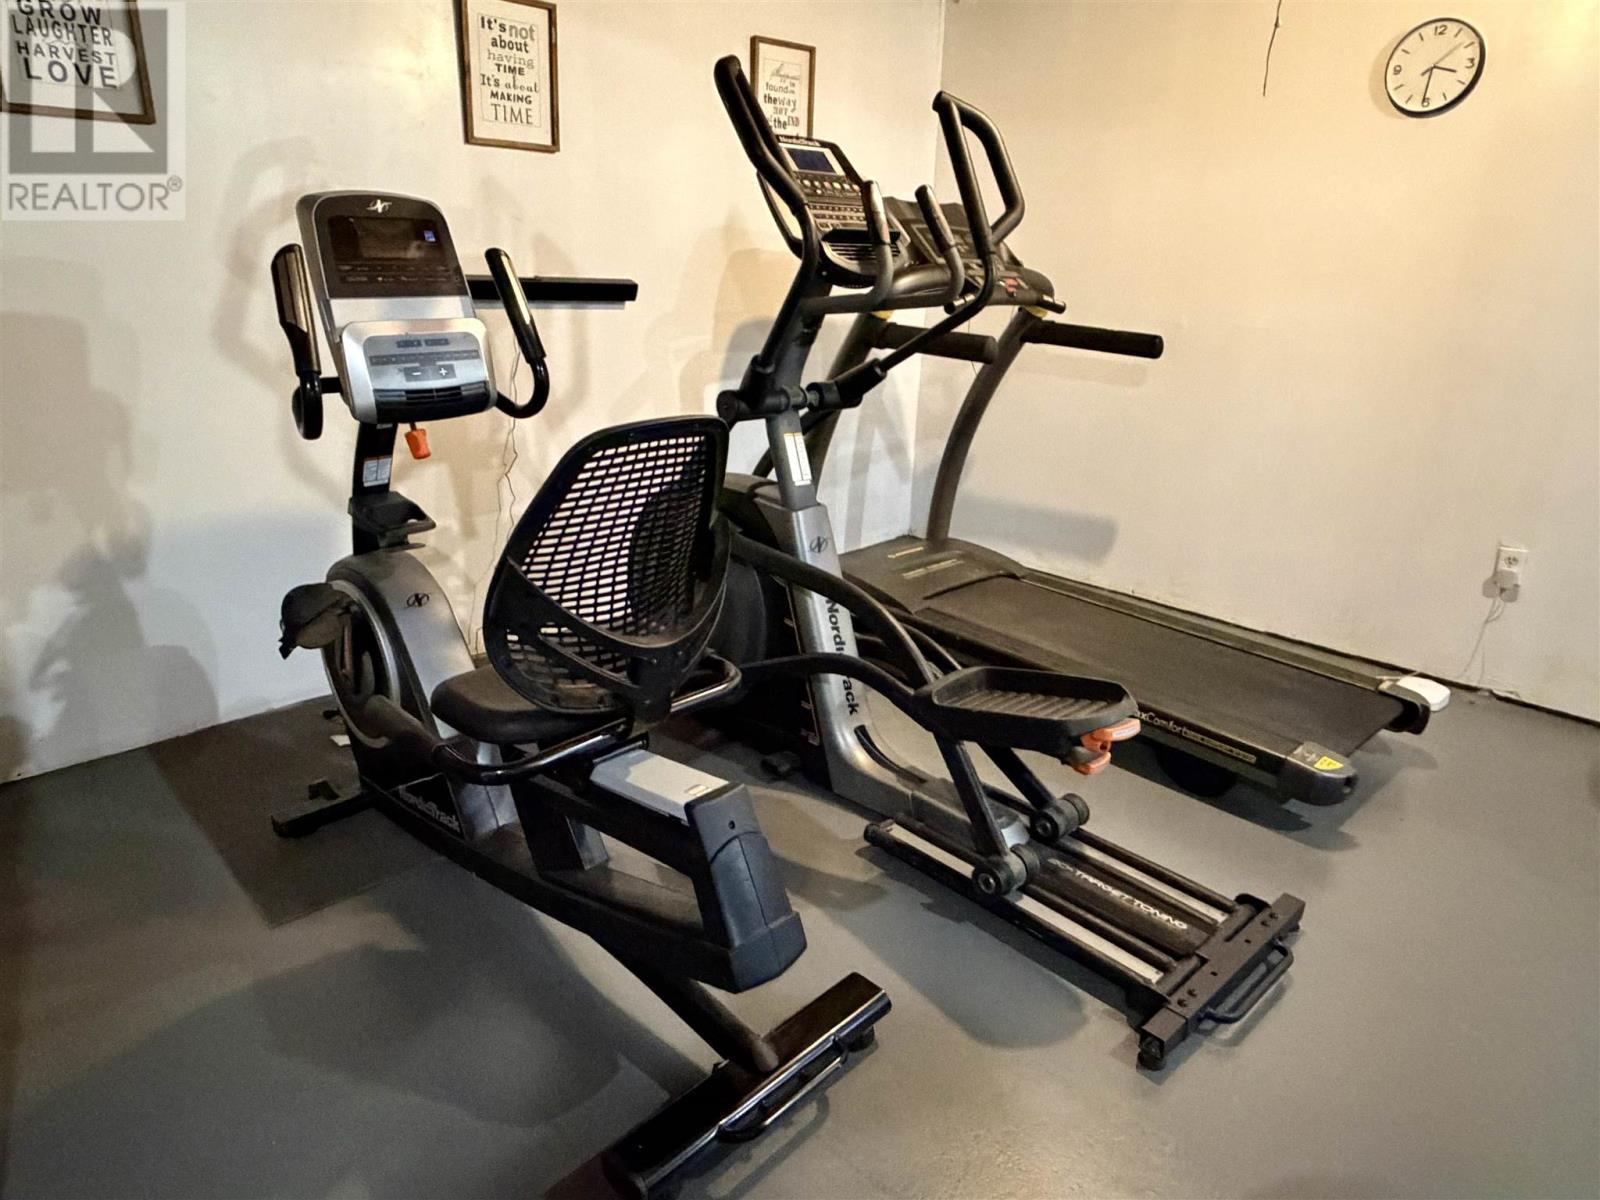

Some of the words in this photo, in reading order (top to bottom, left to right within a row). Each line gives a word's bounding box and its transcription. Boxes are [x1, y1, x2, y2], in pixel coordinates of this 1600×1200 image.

[17, 0, 101, 25] GROW
[11, 14, 114, 47] LAUGHTER
[480, 16, 507, 32] It's
[509, 23, 535, 41] not
[1433, 24, 1448, 36] 12
[491, 35, 530, 53] about
[16, 41, 116, 66] HARVEST
[487, 49, 535, 69] having
[495, 63, 526, 76] TIME
[1393, 65, 1402, 75] 9
[1465, 57, 1475, 69] 3
[23, 57, 118, 88] LOVE
[480, 73, 501, 87] It's
[490, 90, 533, 105] MAKING
[764, 94, 778, 105] the
[1421, 97, 1431, 108] 6
[491, 103, 534, 125] TIME
[773, 117, 787, 130] the
